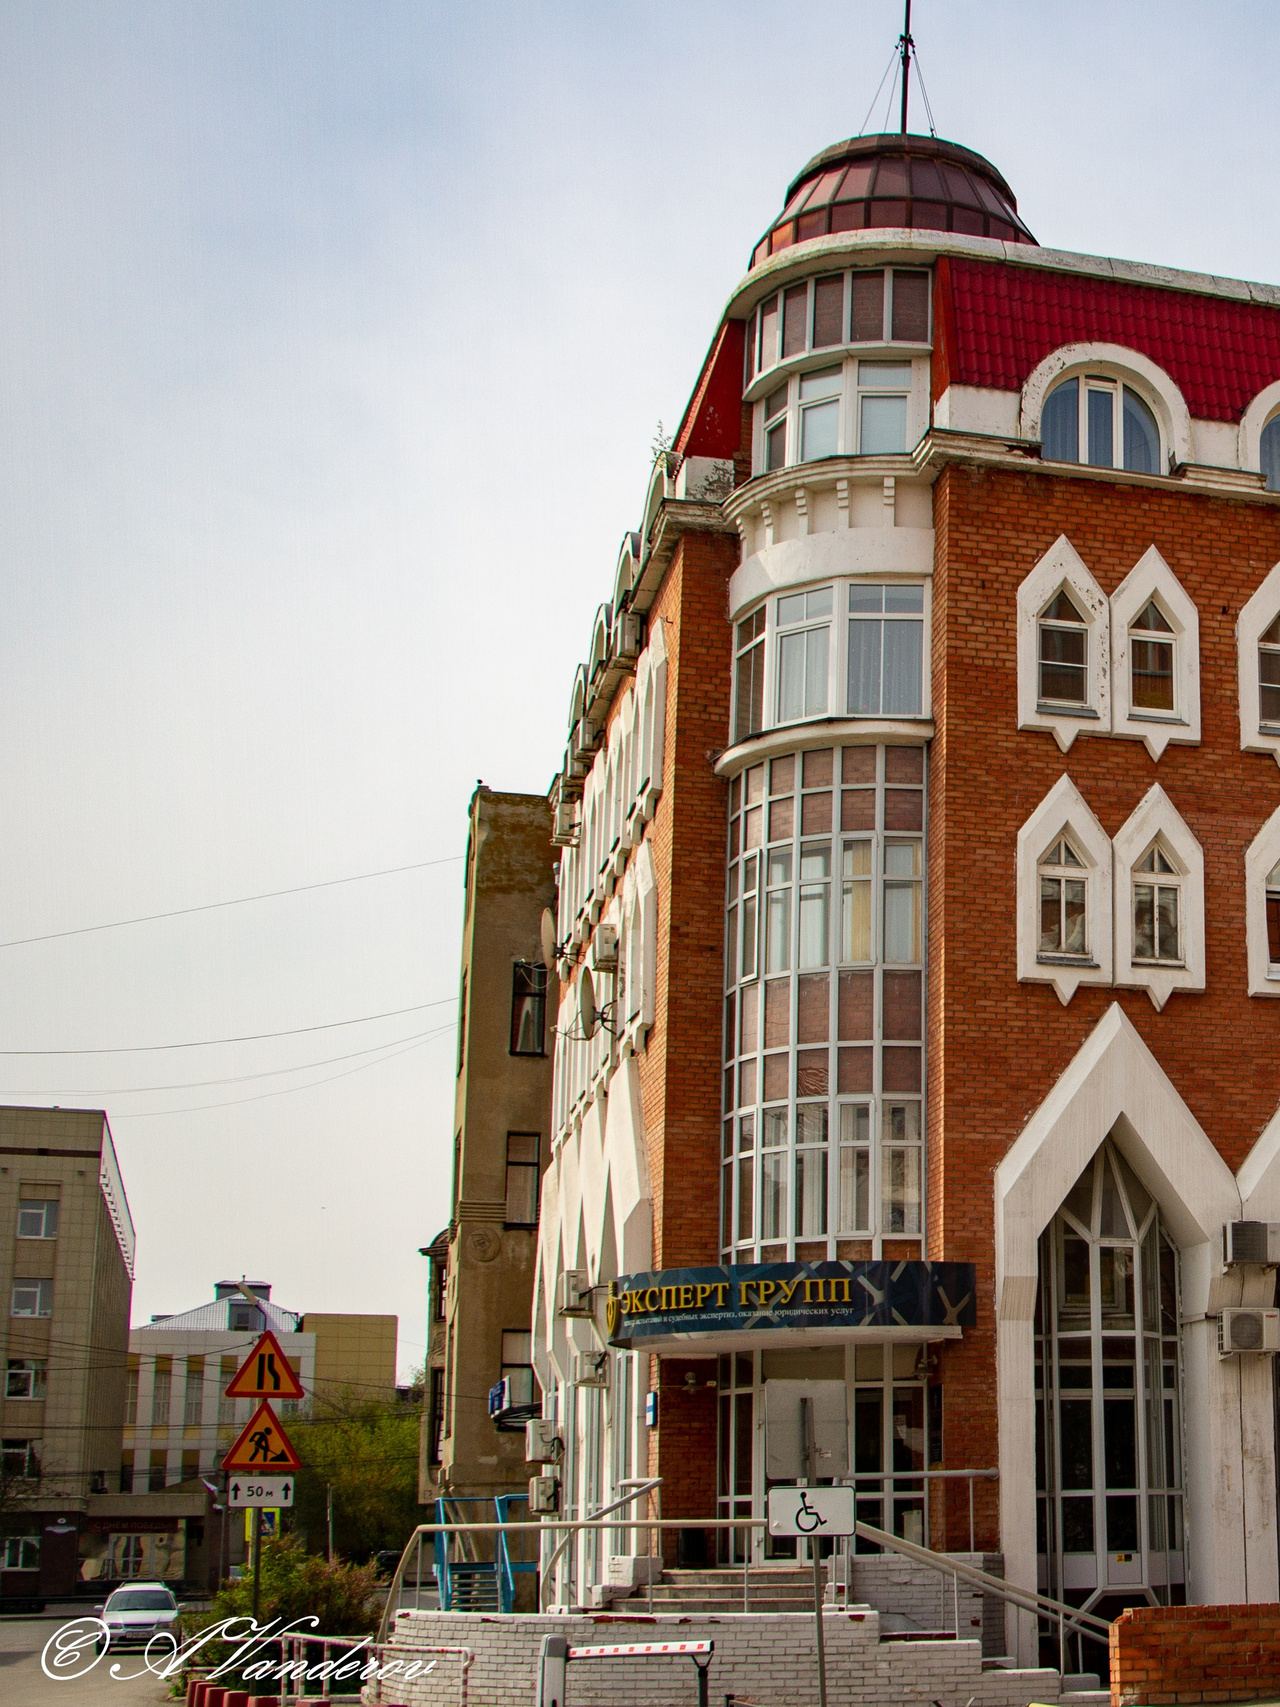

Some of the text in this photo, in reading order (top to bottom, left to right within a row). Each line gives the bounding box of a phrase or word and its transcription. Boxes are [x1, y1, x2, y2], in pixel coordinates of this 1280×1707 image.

[620, 1278, 853, 1314] ЭКСПЕРТ ГРУПП
[668, 1312, 698, 1323] судебных
[738, 1309, 773, 1318] оказание
[774, 1307, 829, 1318] юридических
[830, 1306, 855, 1317] услуг
[247, 1486, 264, 1497] 50
